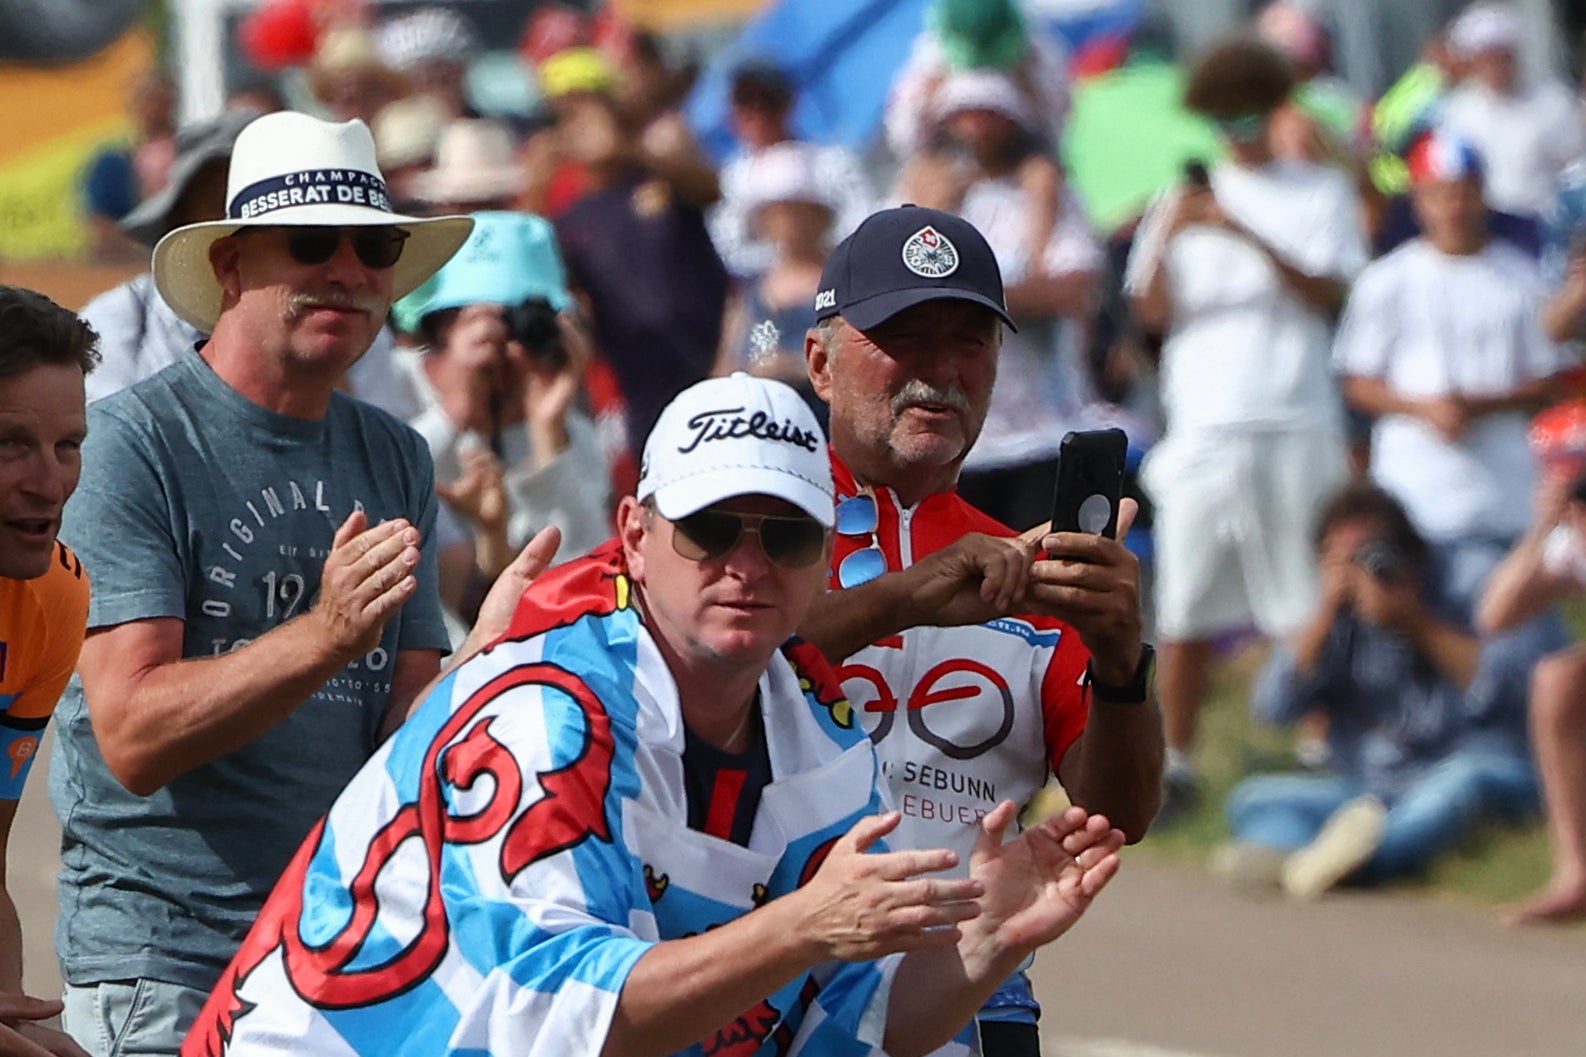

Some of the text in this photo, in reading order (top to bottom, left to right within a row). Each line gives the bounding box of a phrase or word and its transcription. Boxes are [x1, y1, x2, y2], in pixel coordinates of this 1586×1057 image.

[240, 185, 392, 219] BESSERAT DE BE
[677, 406, 818, 453] Titleist
[201, 480, 330, 618] ORIGINAL
[903, 761, 996, 804] SEBUNN
